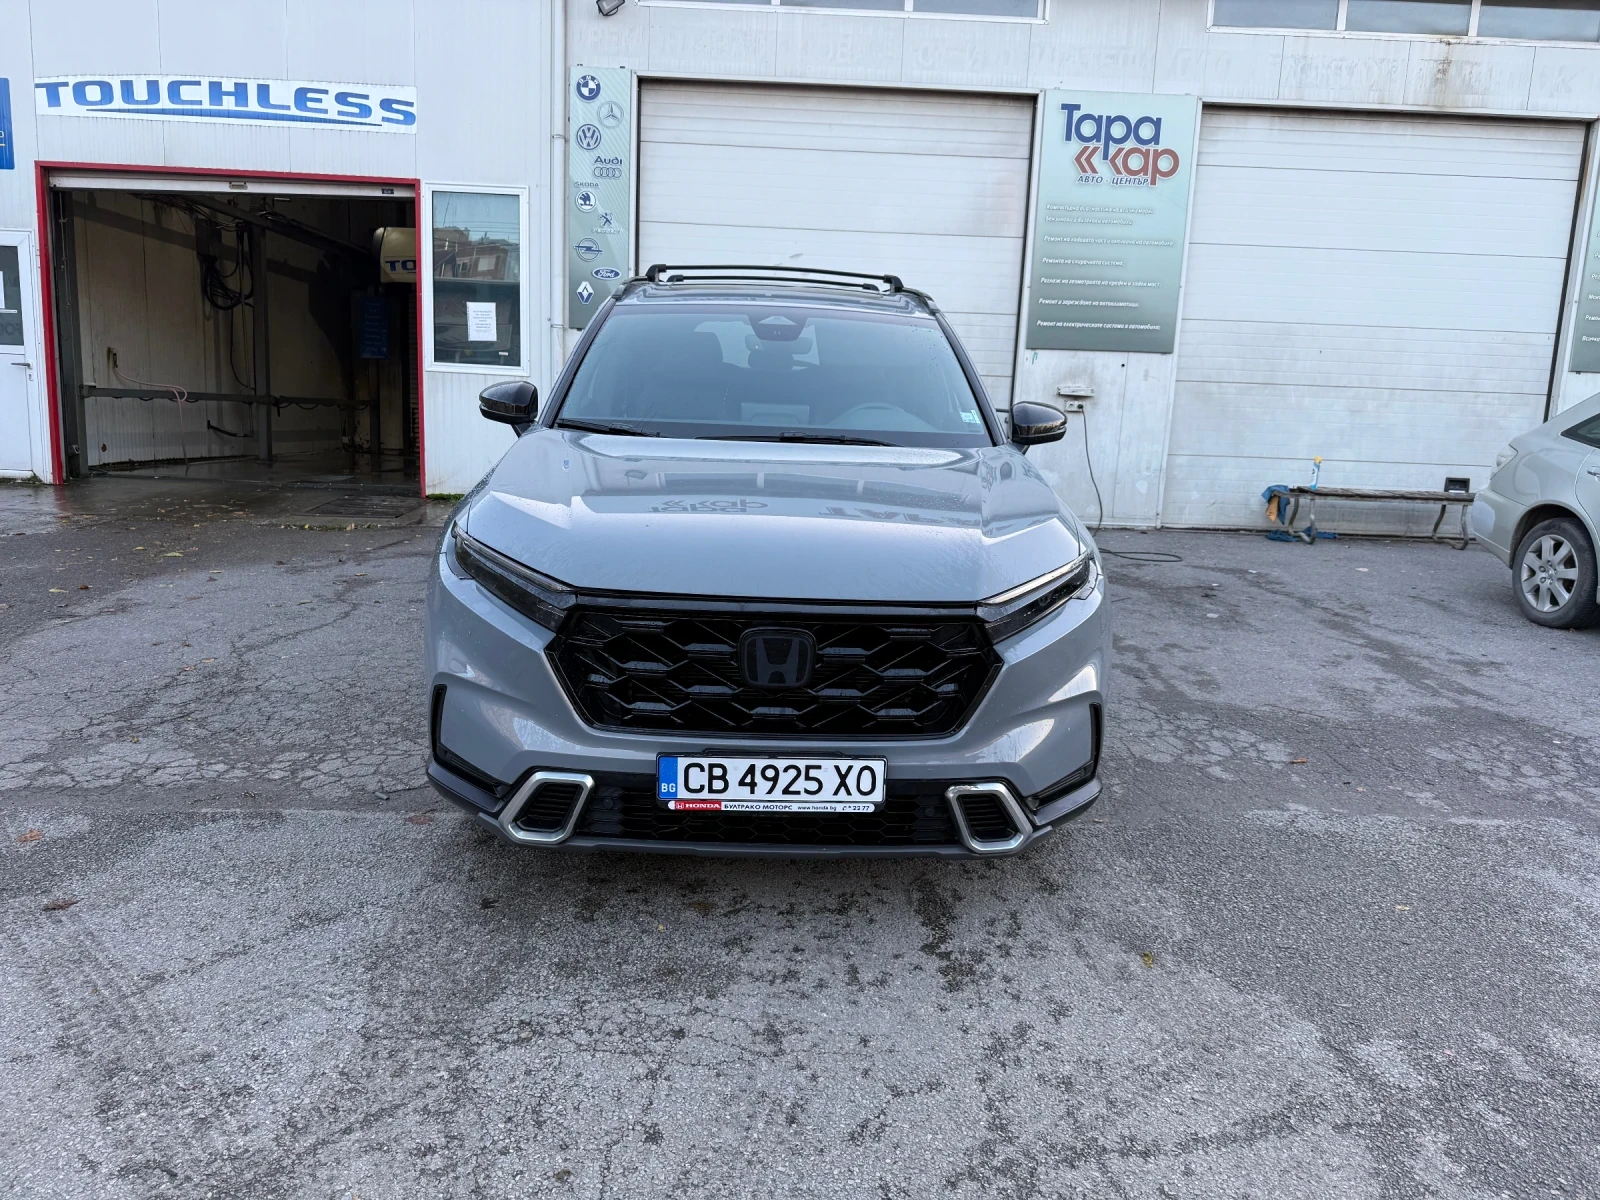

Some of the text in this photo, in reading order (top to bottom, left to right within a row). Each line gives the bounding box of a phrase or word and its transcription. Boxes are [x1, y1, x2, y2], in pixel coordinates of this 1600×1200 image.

[34, 79, 416, 126] TOUCHLESS
[1060, 103, 1162, 160] Тара
[594, 156, 622, 165] Audi
[1077, 175, 1149, 186] АВТО ЦЕНТЪР
[661, 783, 676, 793] BG
[683, 762, 877, 797] CB 4925 XO
